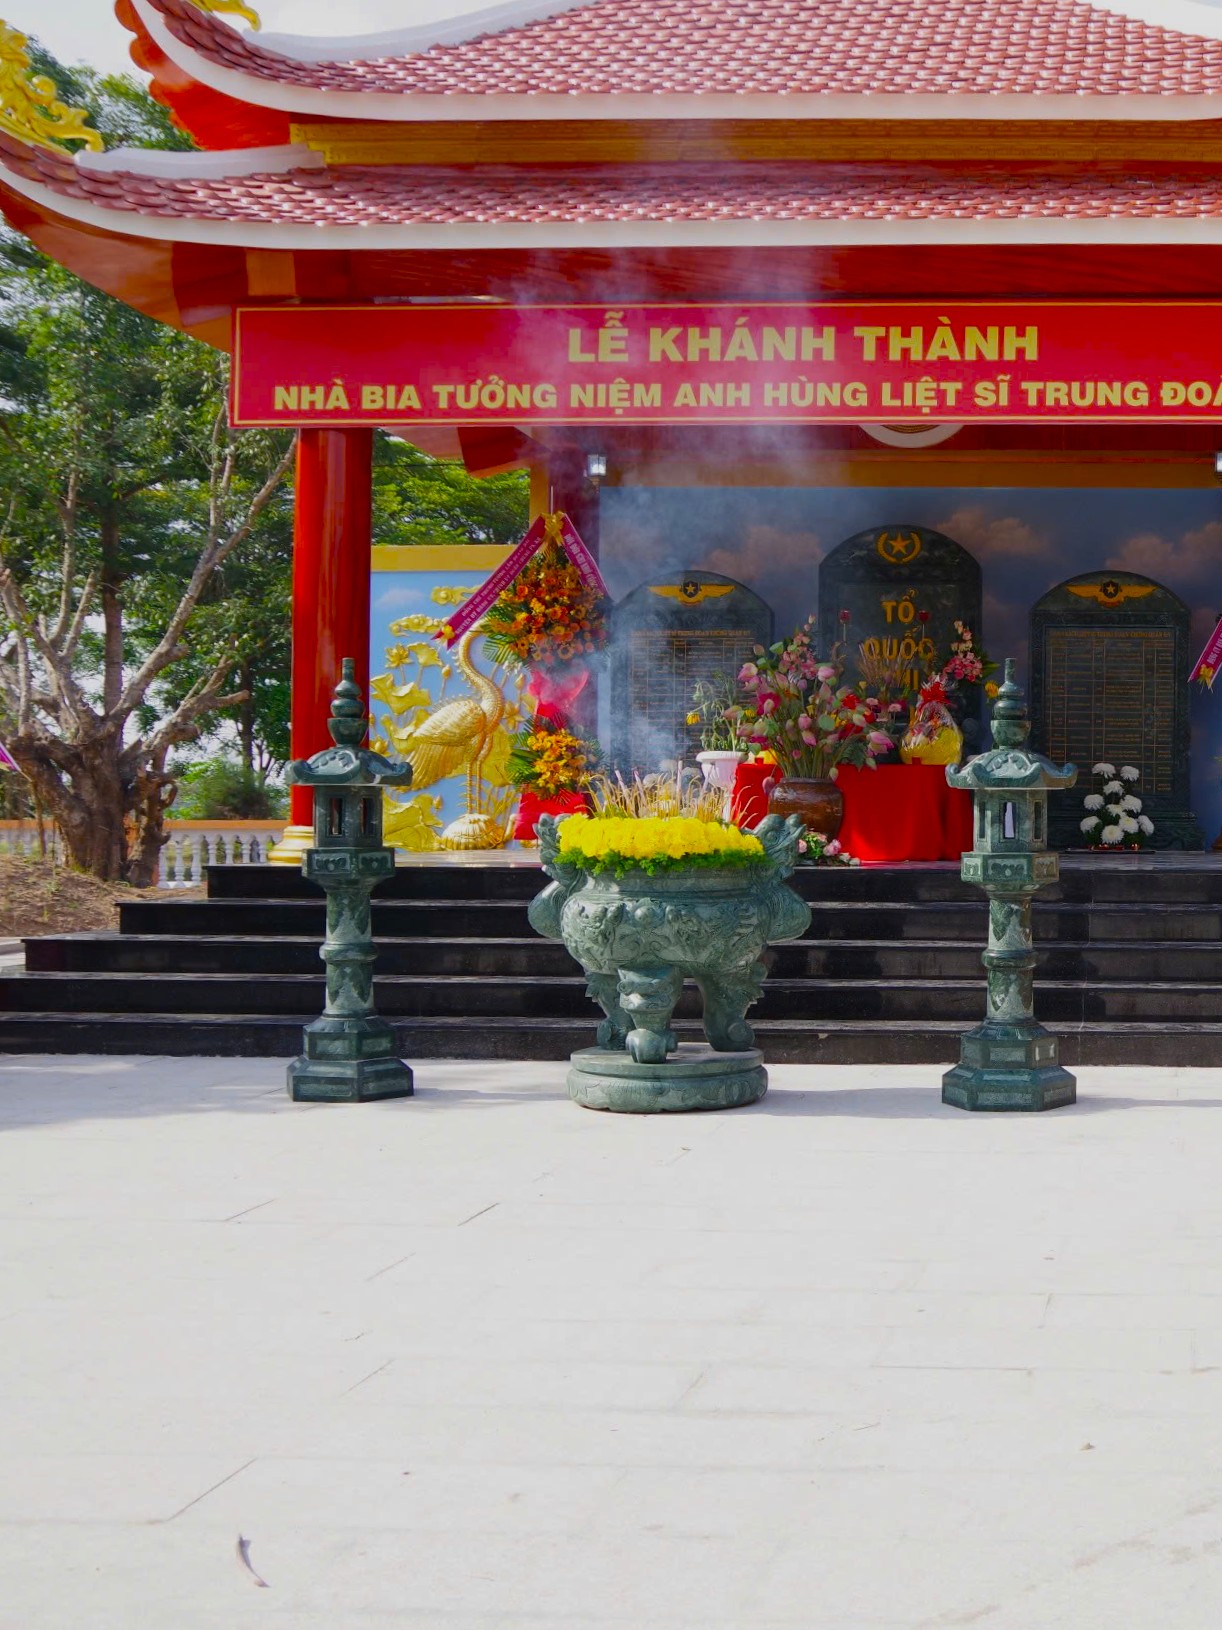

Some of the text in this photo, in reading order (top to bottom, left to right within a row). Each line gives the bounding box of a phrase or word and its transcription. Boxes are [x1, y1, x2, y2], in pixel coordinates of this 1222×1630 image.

[569, 311, 1038, 362] LỄ KHÁNH THÀNH
[275, 378, 348, 410] NHÀ
[362, 385, 420, 409] BIA
[433, 374, 557, 409] TƯỞNG
[570, 378, 661, 415] NIỆM
[674, 383, 749, 408] ANH
[765, 375, 867, 408] HÙNG
[882, 377, 962, 413] LIỆT
[975, 374, 1013, 408] SĨ
[1022, 381, 1148, 407] TRUNG
[882, 588, 918, 624] TỔ
